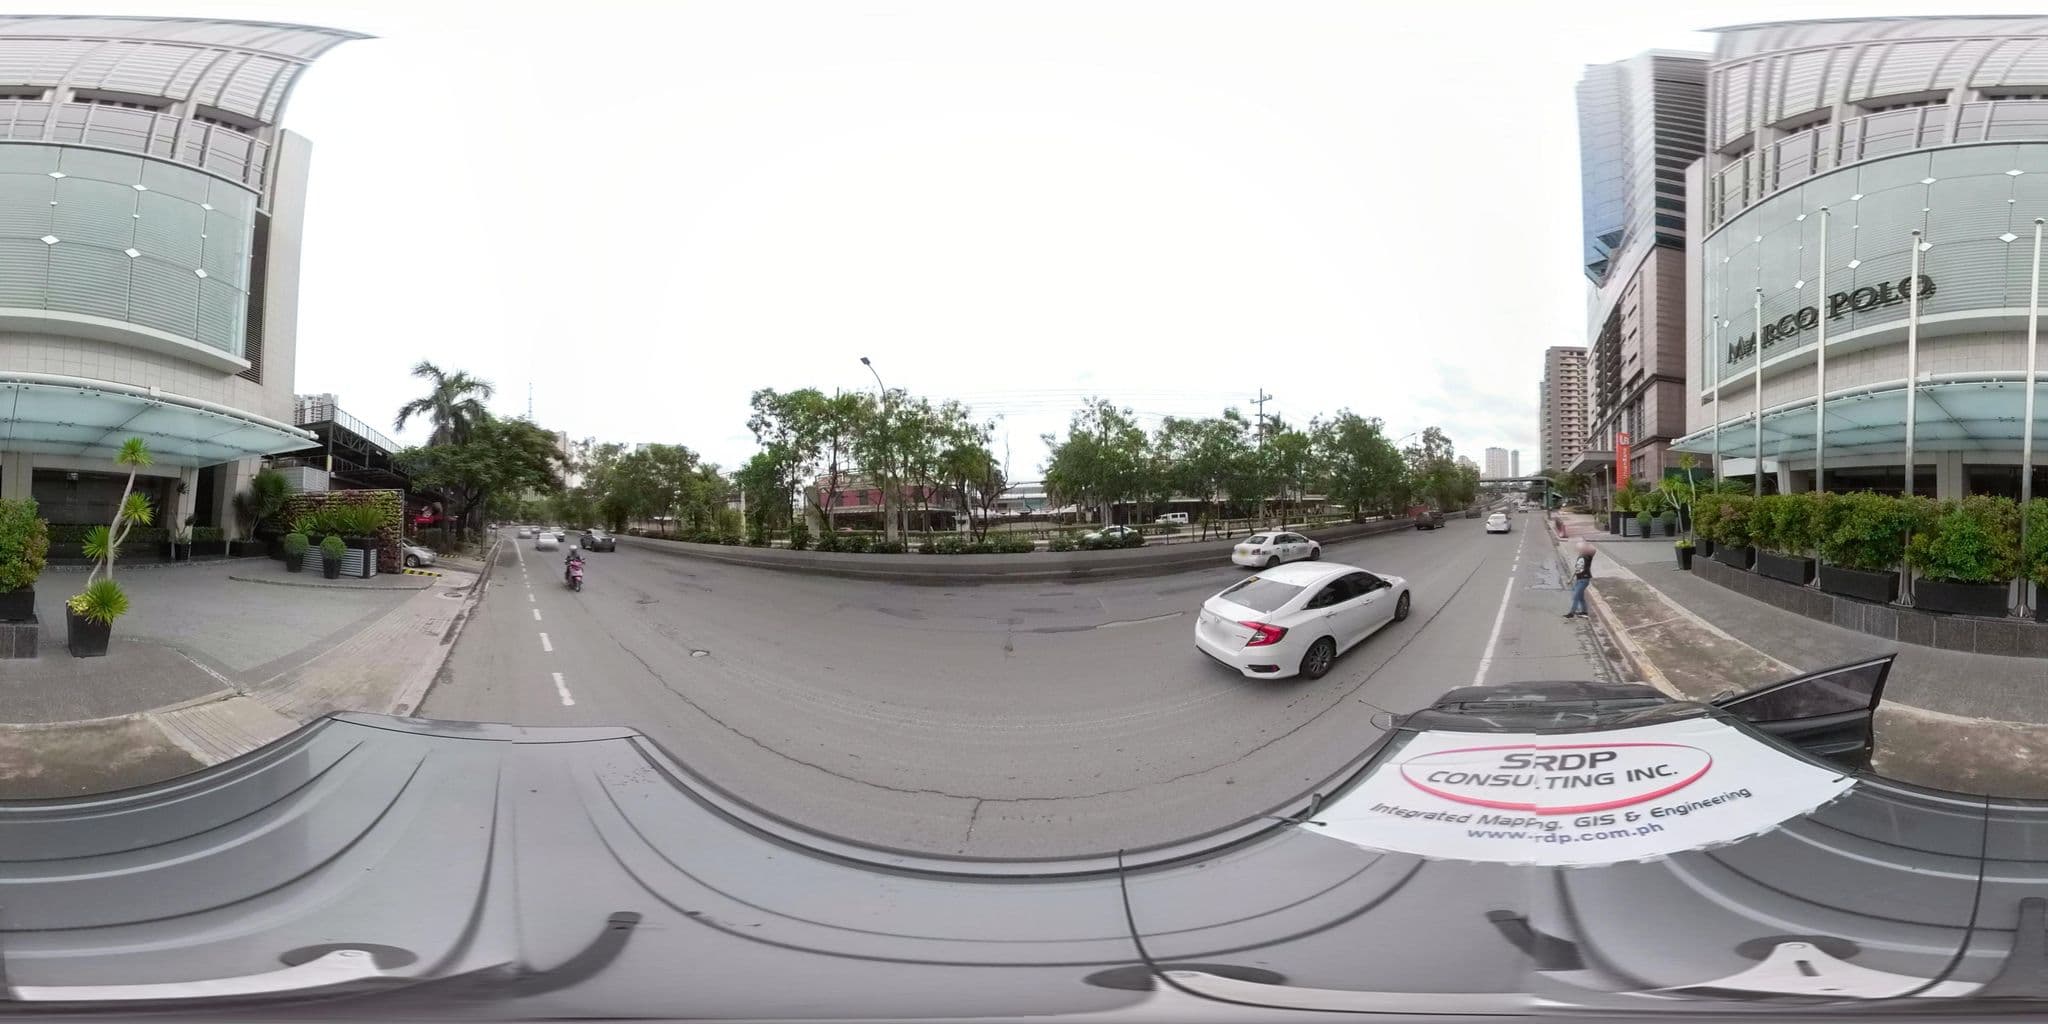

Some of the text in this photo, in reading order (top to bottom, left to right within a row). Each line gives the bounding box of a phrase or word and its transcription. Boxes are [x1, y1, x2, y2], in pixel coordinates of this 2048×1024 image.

[1727, 274, 1936, 364] MARCO POLO
[1499, 751, 1617, 772] SRDP
[1427, 764, 1678, 789] CONSUTING INC.
[1370, 803, 1472, 824] Integrated
[1574, 814, 1616, 828] GIS
[1626, 812, 1641, 822] &
[1651, 788, 1752, 818] Engineering
[1468, 823, 1664, 844] www.rdp.com.ph
